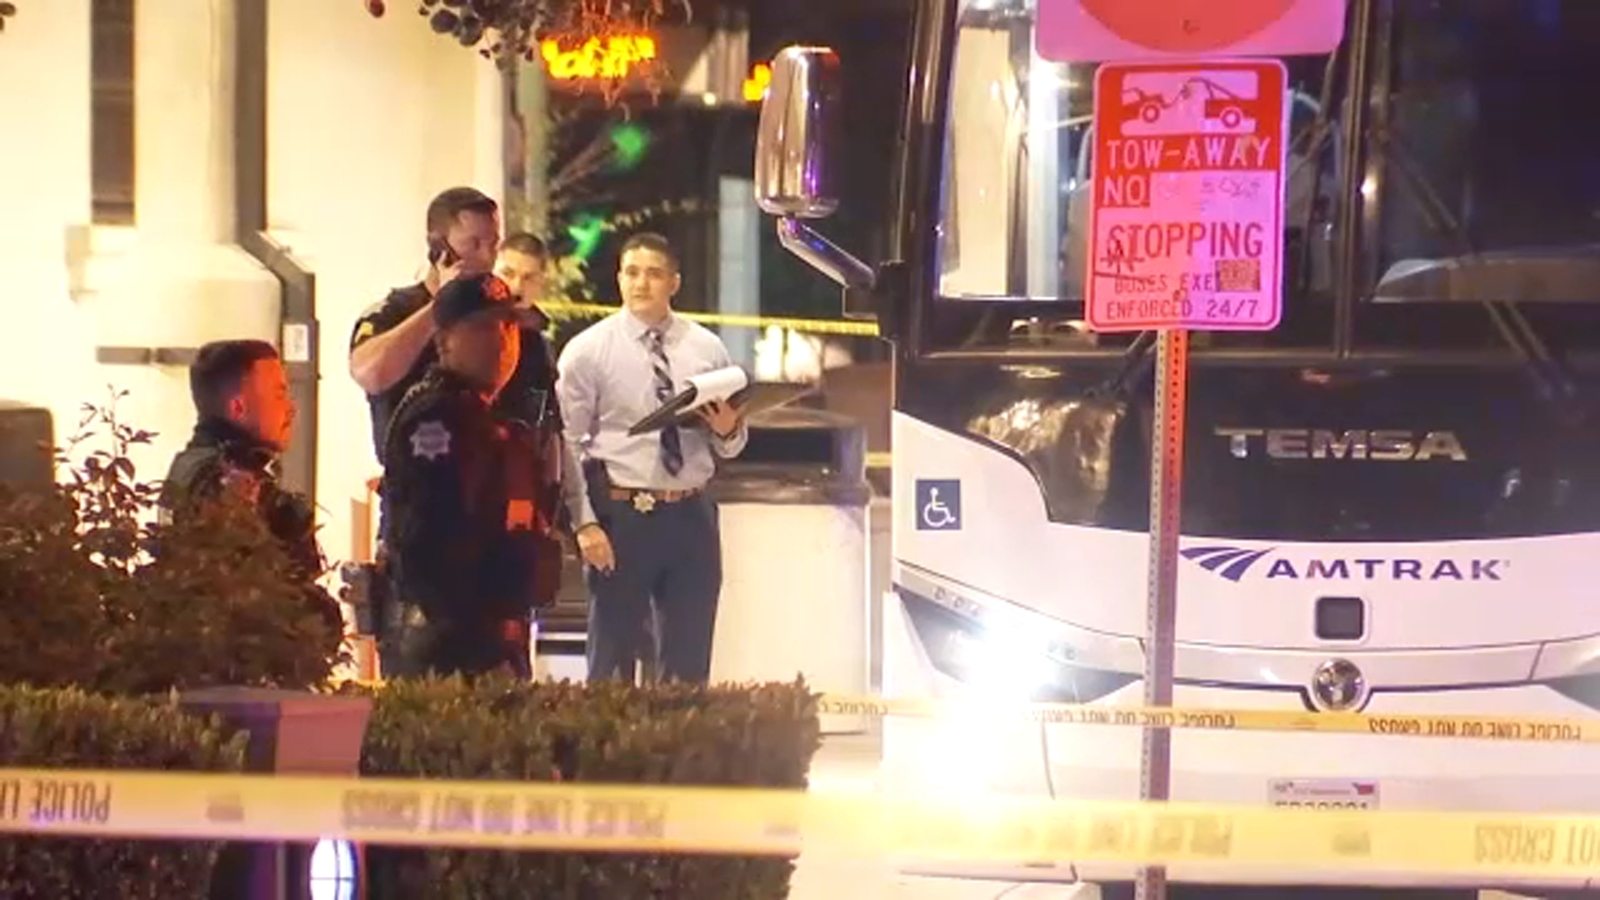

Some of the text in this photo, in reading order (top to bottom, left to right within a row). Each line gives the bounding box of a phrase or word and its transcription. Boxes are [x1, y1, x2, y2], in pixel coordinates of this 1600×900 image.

[1106, 136, 1271, 170] TOW-AWAY
[1103, 175, 1146, 206] NO
[1107, 222, 1264, 259] STOPPING
[1179, 272, 1214, 292] EXE
[1106, 299, 1259, 321] ENFORCED 24/7
[1213, 427, 1467, 462] TEMSA
[1265, 558, 1502, 581] AMTRAK
[29, 779, 111, 824] POLICE
[1563, 824, 1600, 866] OT
